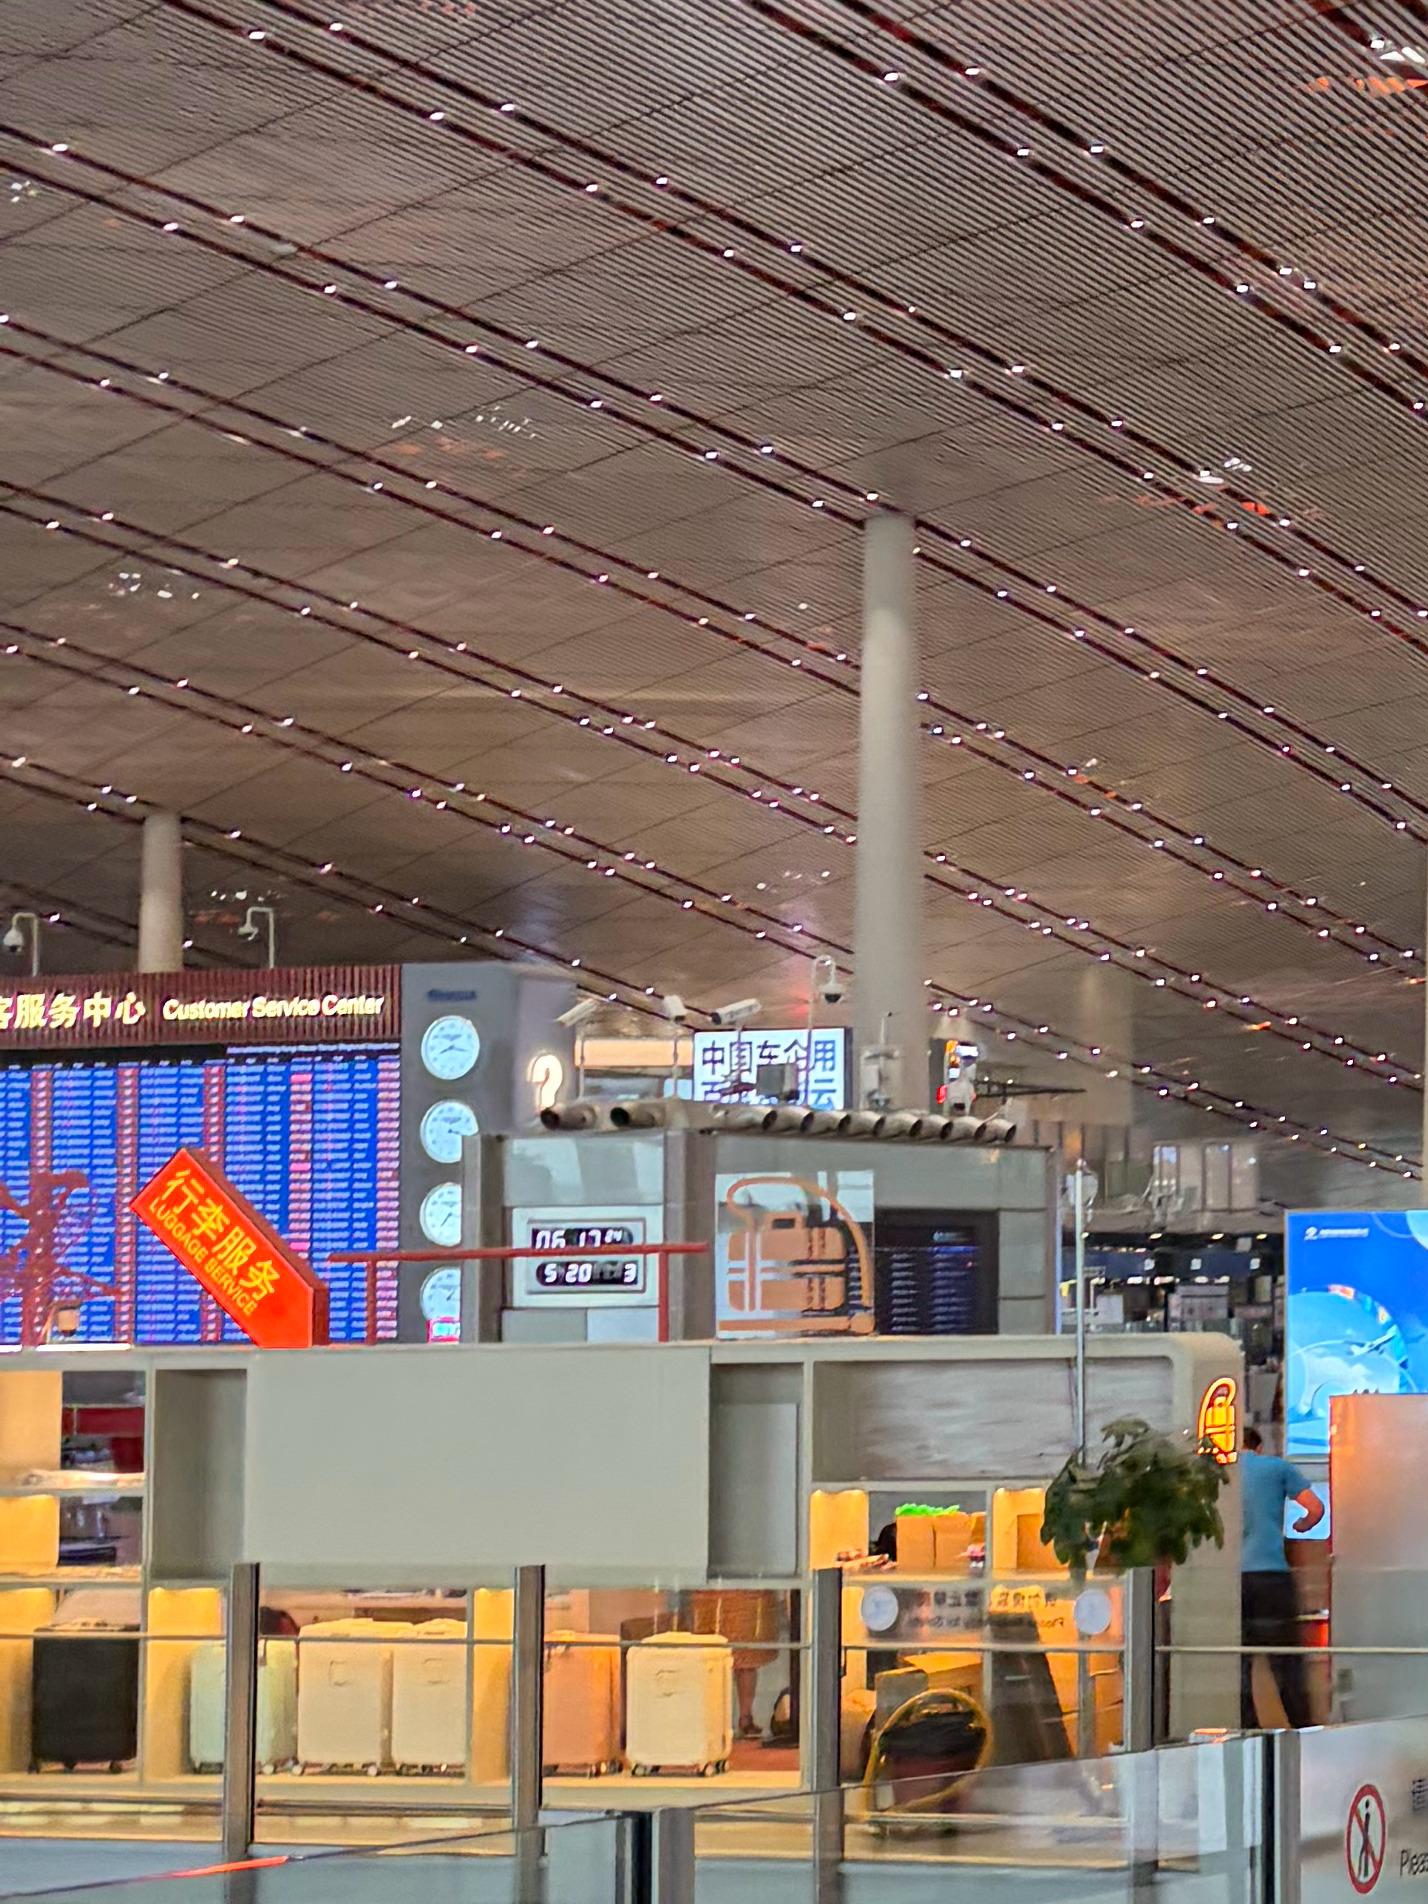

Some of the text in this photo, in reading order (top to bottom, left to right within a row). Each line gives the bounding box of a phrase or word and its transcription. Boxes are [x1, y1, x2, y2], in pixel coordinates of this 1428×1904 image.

[163, 994, 384, 1021] Customer Service Center
[149, 1197, 209, 1263] LUGGAGE
[161, 1169, 280, 1301] 行李服务
[565, 1263, 593, 1283] 20
